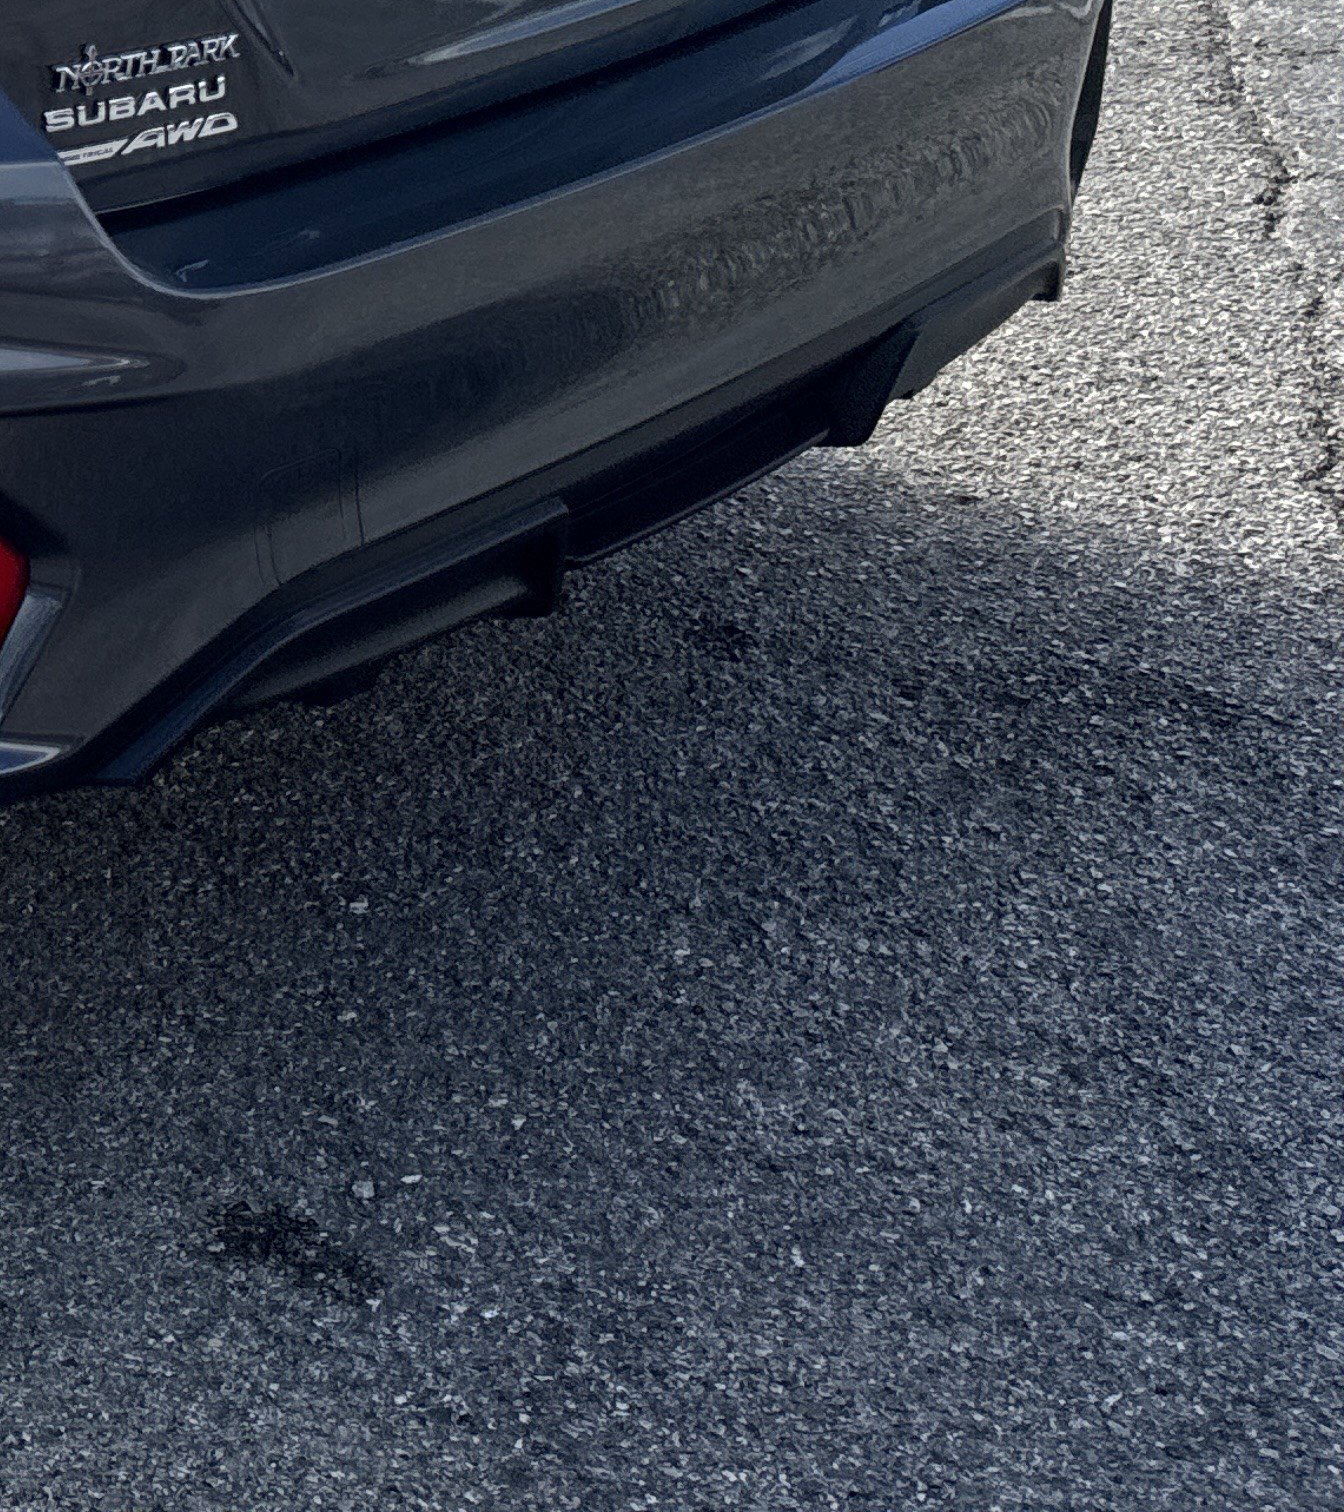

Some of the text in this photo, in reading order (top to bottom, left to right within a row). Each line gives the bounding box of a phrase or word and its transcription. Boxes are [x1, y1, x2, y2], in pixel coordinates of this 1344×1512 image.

[55, 34, 241, 96] NORTH PARK
[44, 76, 225, 133] SUBARU
[121, 112, 238, 156] AWD
